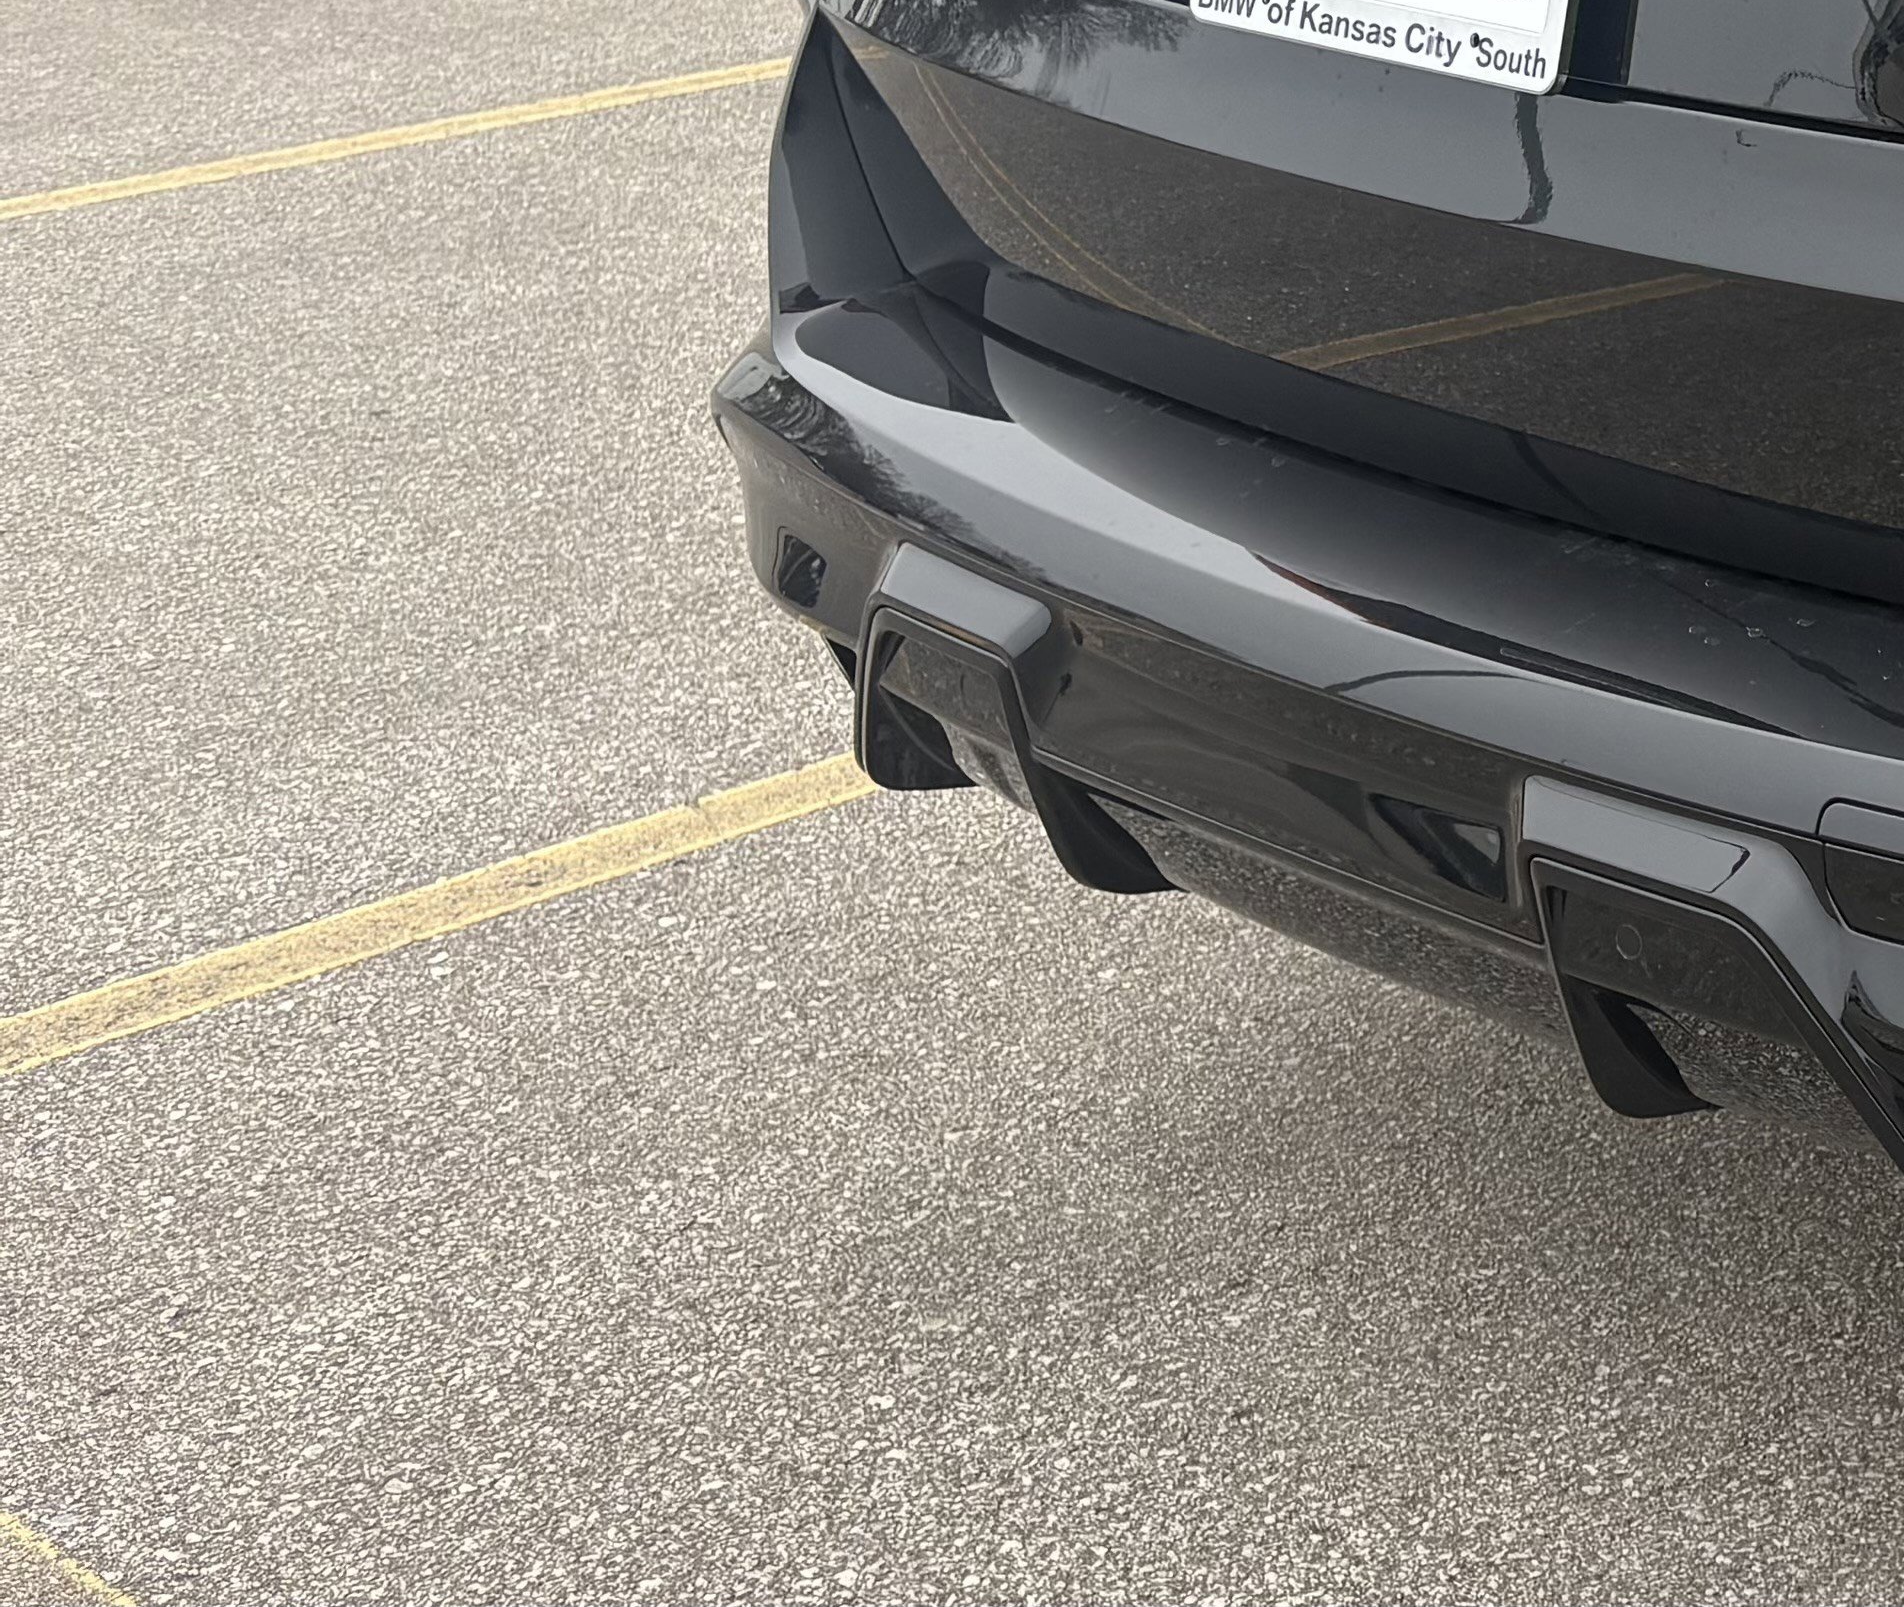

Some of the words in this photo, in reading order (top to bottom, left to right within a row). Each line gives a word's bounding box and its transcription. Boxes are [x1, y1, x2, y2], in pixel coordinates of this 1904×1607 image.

[1299, 0, 1397, 48] Kansas
[1404, 22, 1462, 67] City
[1476, 37, 1547, 79] South
